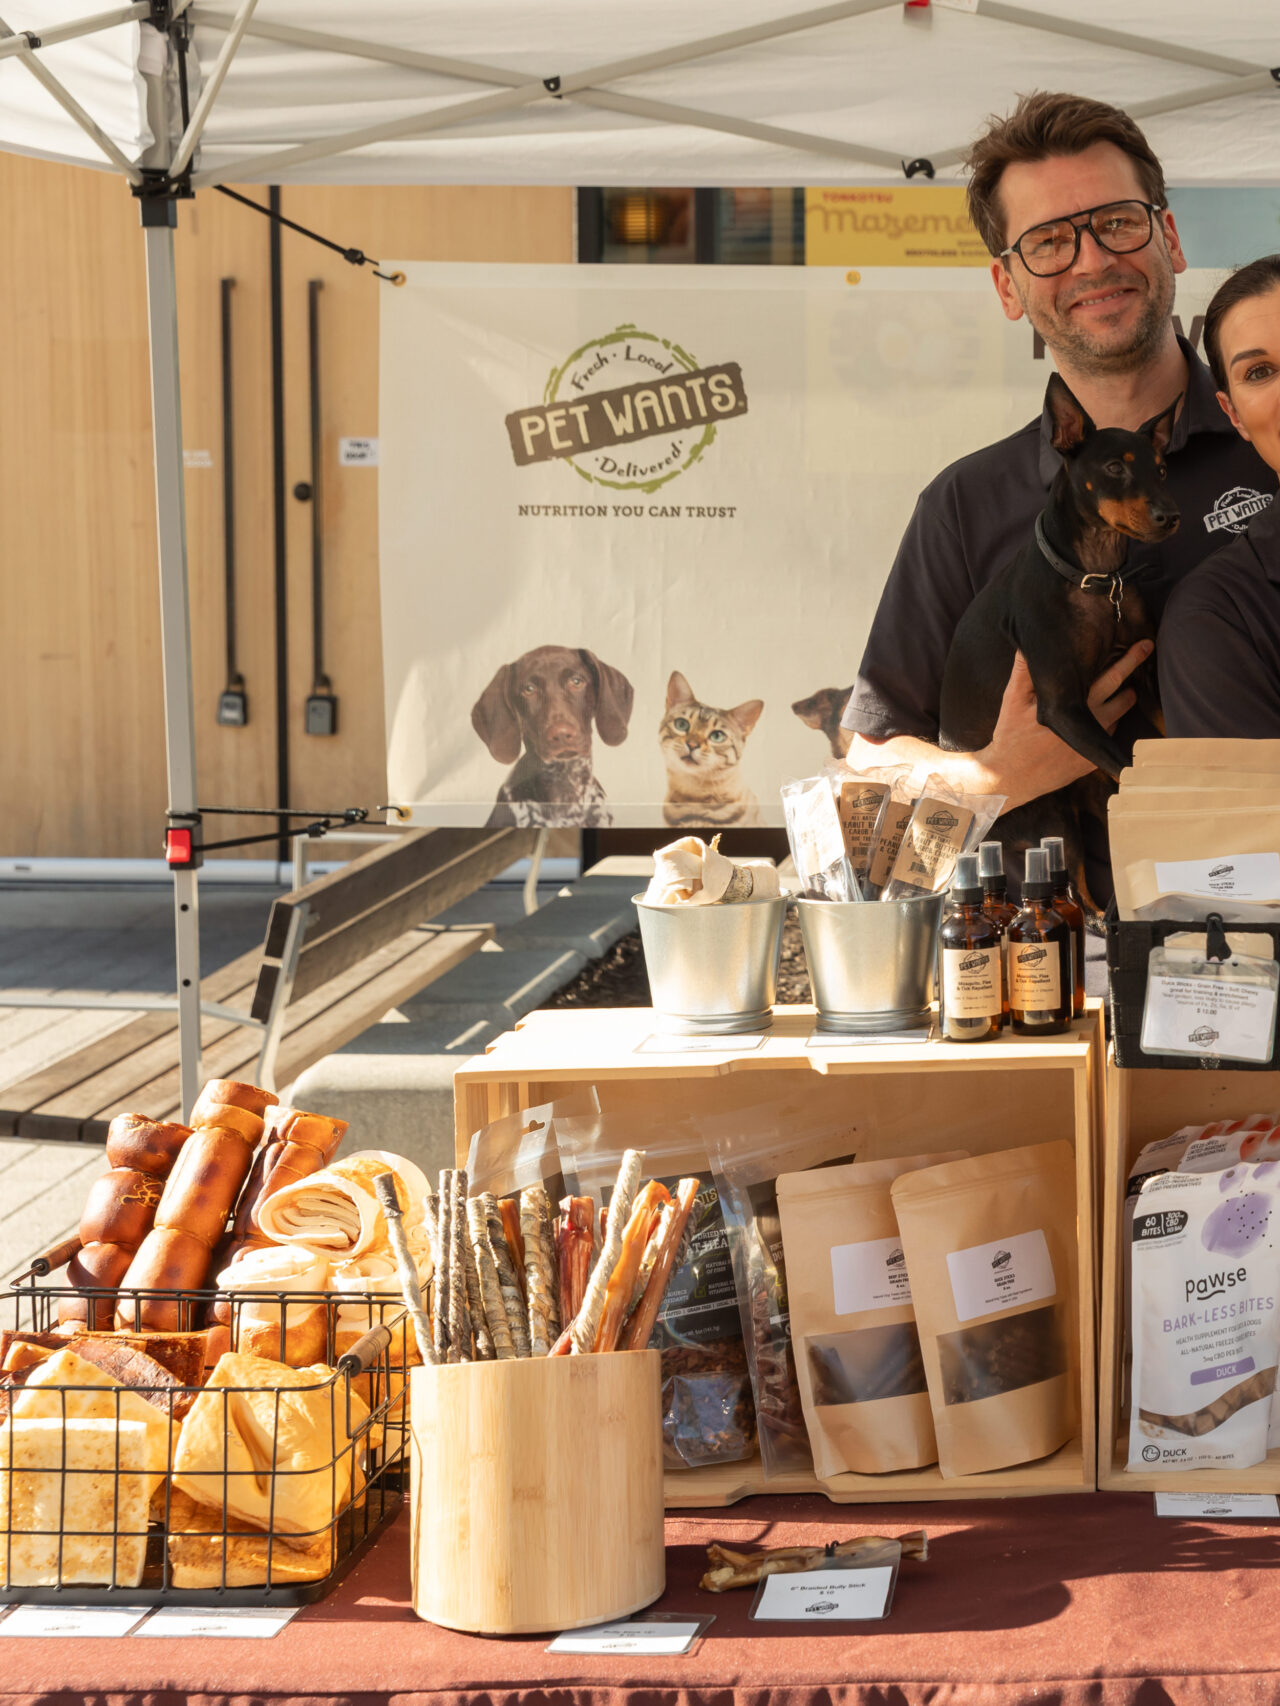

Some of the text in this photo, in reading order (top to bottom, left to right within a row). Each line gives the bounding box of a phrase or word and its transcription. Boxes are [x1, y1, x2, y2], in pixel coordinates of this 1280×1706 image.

[805, 203, 978, 240] Mazeme
[571, 345, 674, 391] Fresh Local
[520, 373, 737, 456] PET WANTS
[600, 442, 682, 478] Delivered
[518, 505, 737, 518] NUTRITION YOU CAN TRUST
[1208, 510, 1230, 529] PET
[1141, 1219, 1179, 1237] BITES CBD
[1145, 1216, 1157, 1227] 60
[1185, 1267, 1247, 1302] pawse
[1163, 1296, 1274, 1333] BARK-LESS BITES
[1175, 1328, 1228, 1345] HEALTH SUPPLEMENT
[1216, 1364, 1237, 1378] DUCK
[1163, 1448, 1187, 1457] DUCK
